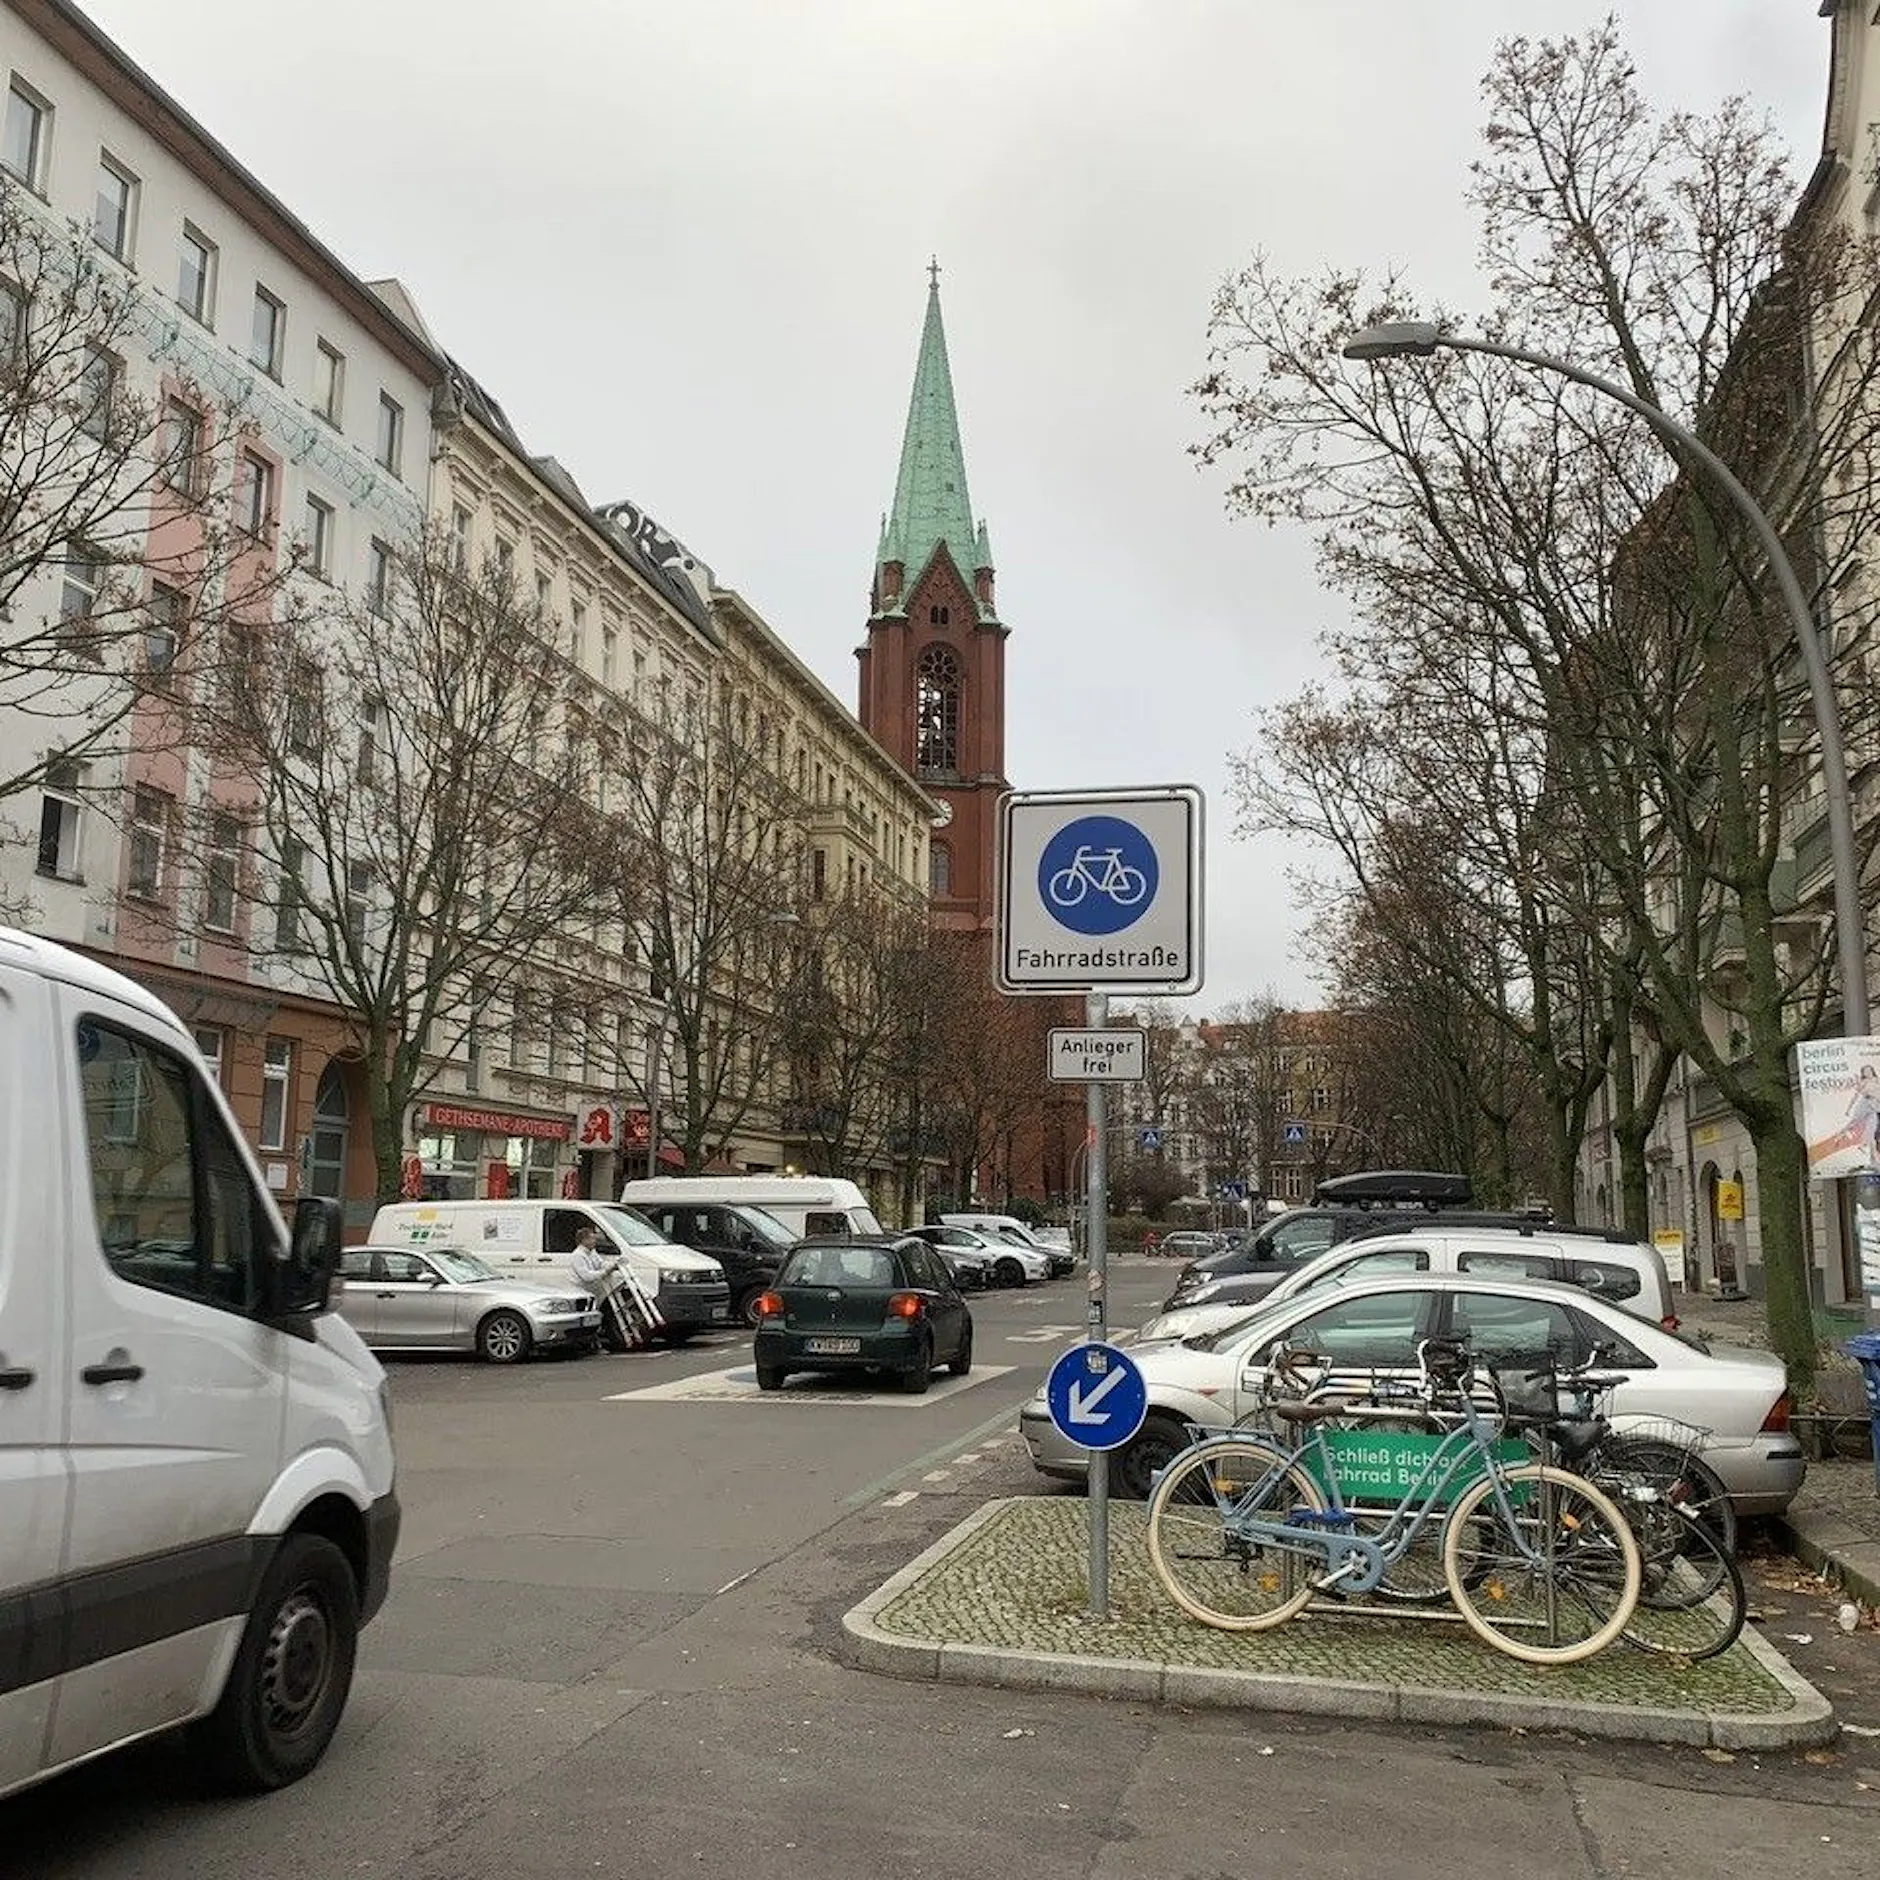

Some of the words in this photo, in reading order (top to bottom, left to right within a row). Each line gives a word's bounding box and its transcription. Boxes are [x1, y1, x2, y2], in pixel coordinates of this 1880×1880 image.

[1017, 946, 1179, 968] Fahrradstraße
[1061, 1039, 1134, 1056] Anlieger
[1802, 1046, 1845, 1060] berlin
[1083, 1058, 1112, 1073] frei
[1803, 1061, 1849, 1075] circus
[1804, 1073, 1860, 1090] festival
[1327, 1446, 1391, 1464] Schließ
[1395, 1450, 1434, 1467] dich
[1323, 1466, 1392, 1484] ahrrad
